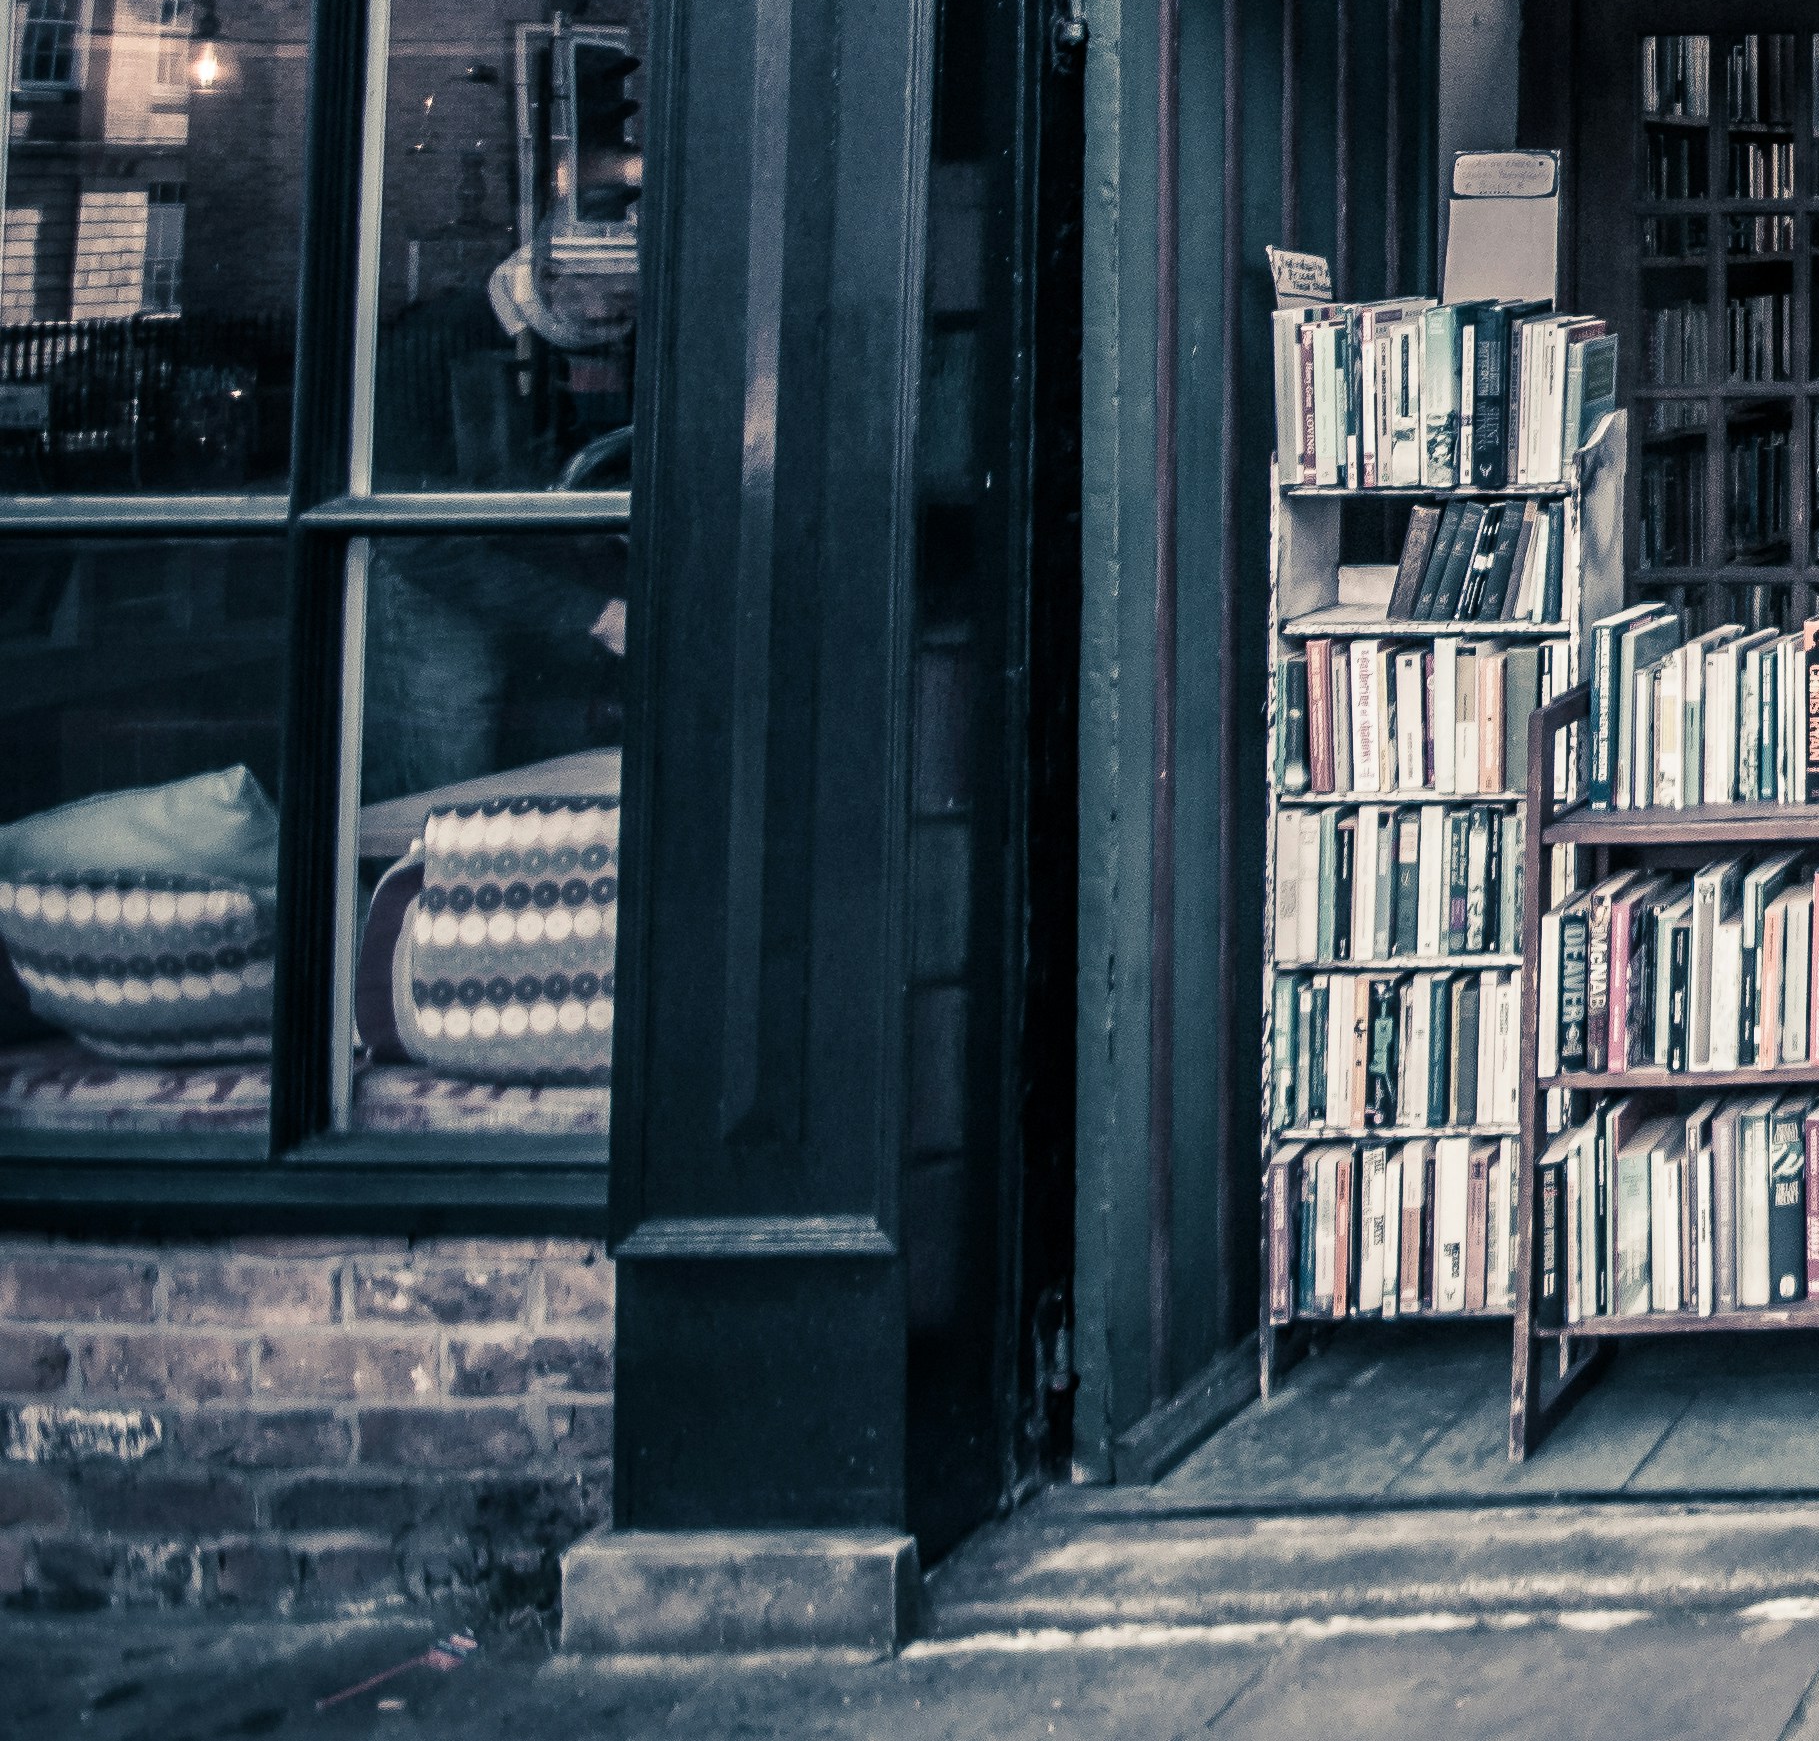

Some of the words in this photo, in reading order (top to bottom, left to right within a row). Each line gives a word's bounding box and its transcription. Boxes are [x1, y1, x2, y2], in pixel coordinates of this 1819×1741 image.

[1305, 413, 1315, 455] LOVING
[1475, 400, 1488, 452] WITNESS
[1487, 405, 1500, 446] SILENT
[1562, 924, 1586, 1023] DEAVER
[1590, 932, 1607, 1008] McNAB
